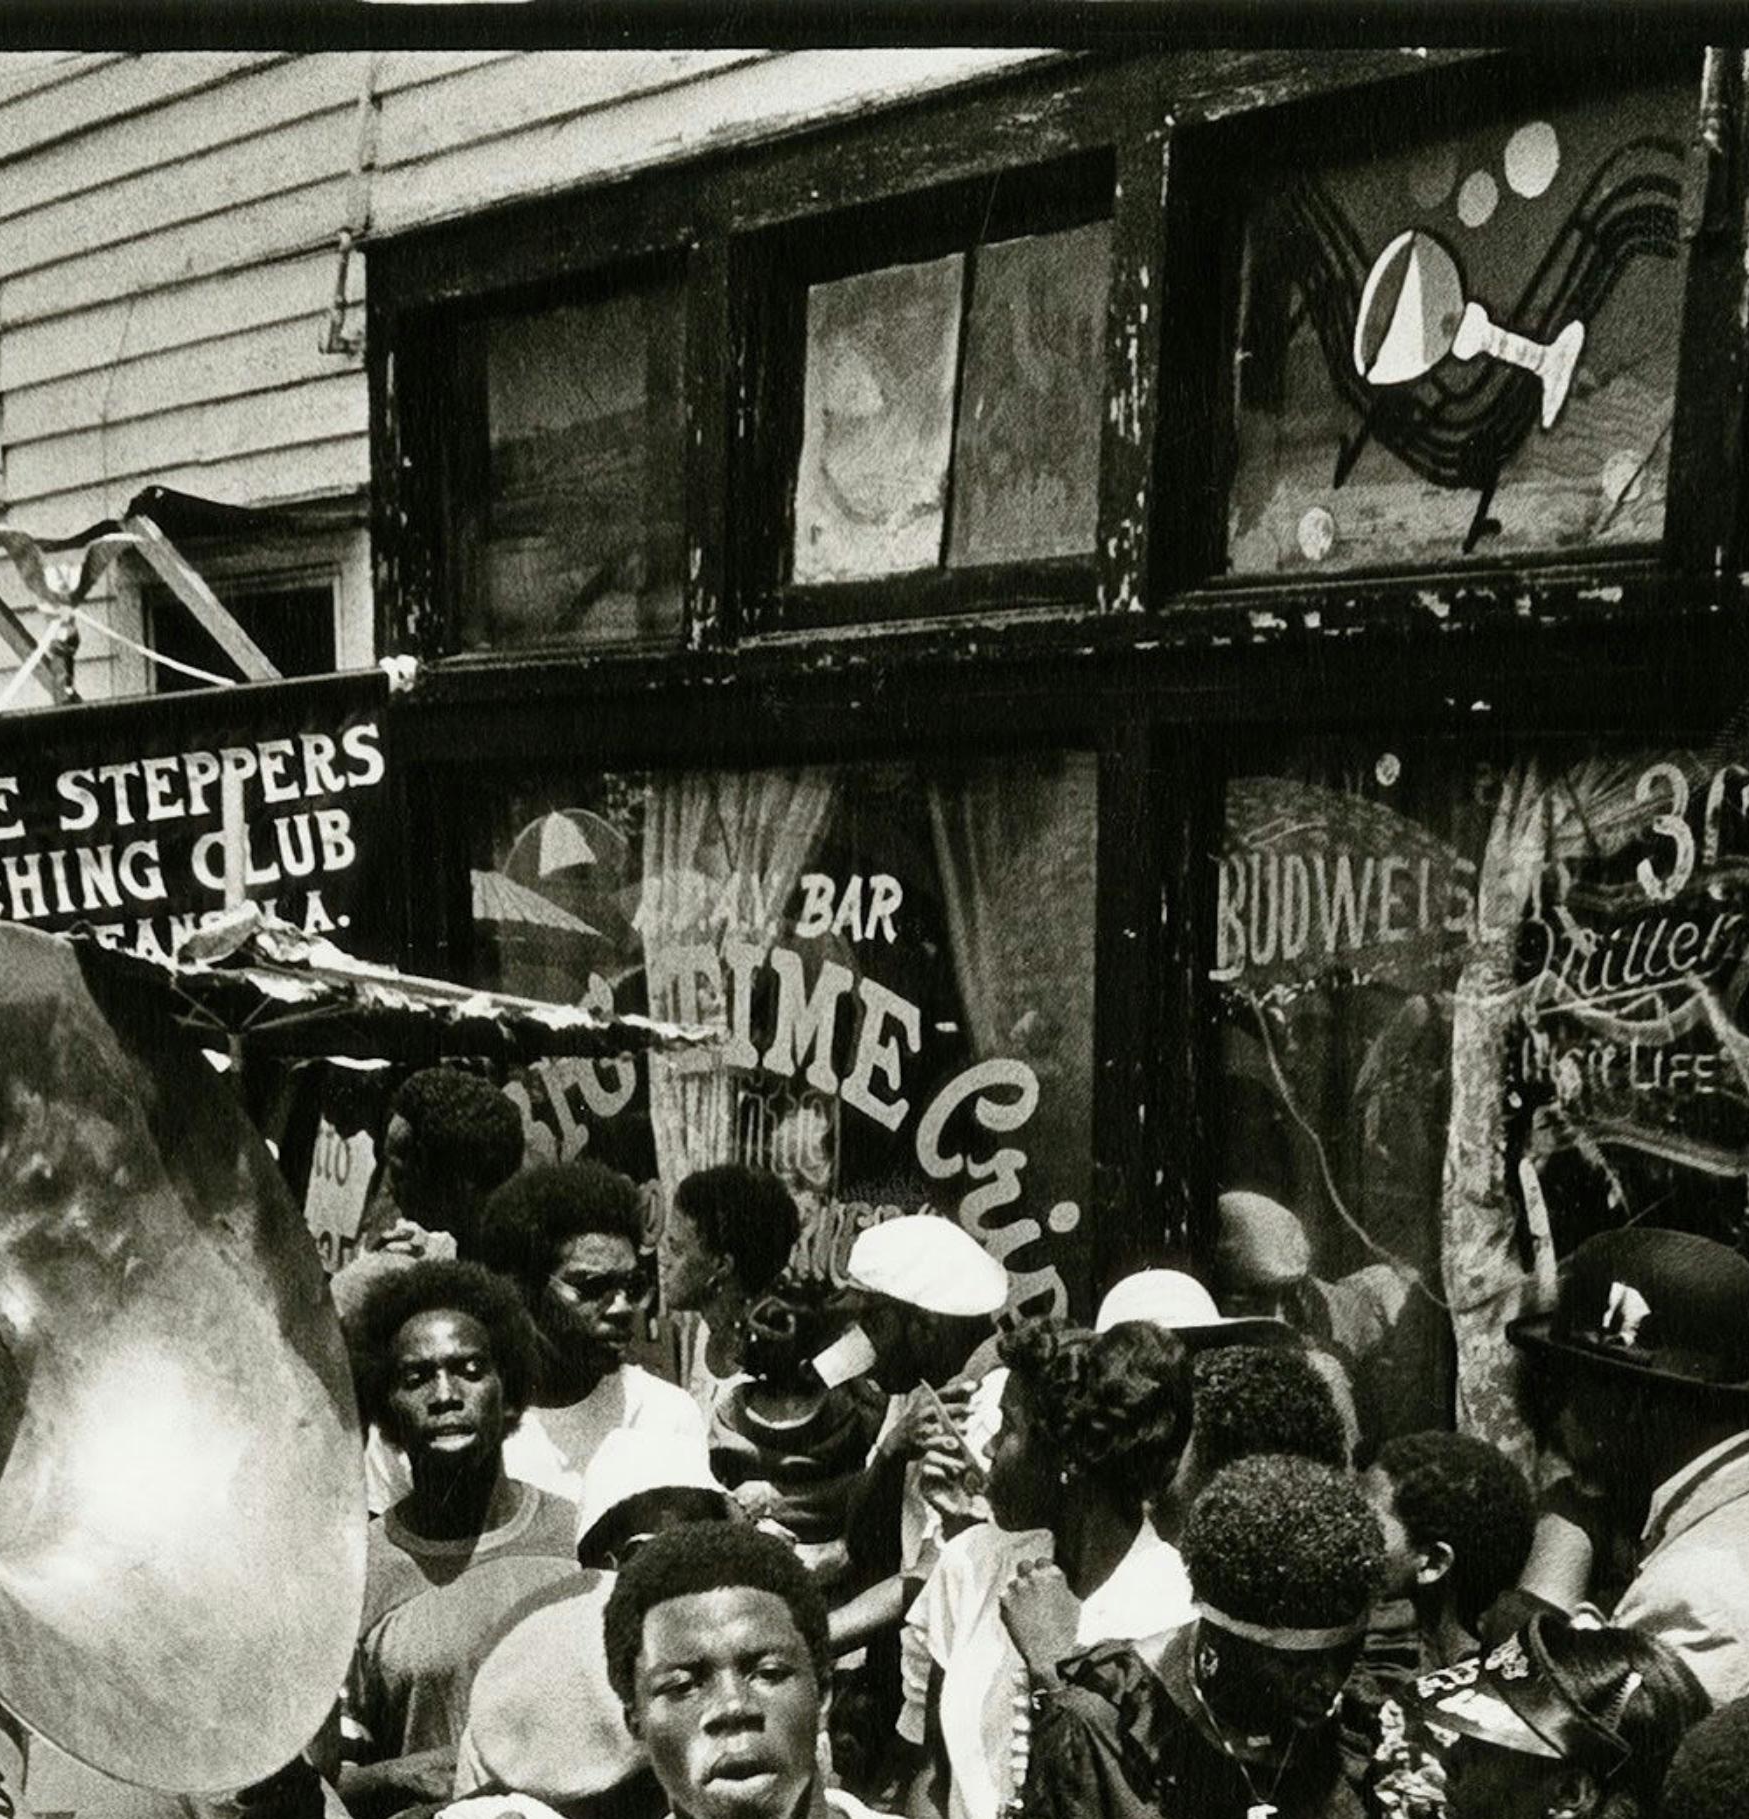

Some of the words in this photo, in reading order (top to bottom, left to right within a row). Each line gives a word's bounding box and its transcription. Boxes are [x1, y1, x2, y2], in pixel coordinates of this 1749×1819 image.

[56, 723, 387, 833] STEPPERS
[191, 808, 357, 892] CLUB
[795, 873, 904, 944] BAR
[647, 940, 921, 1131] TIME
